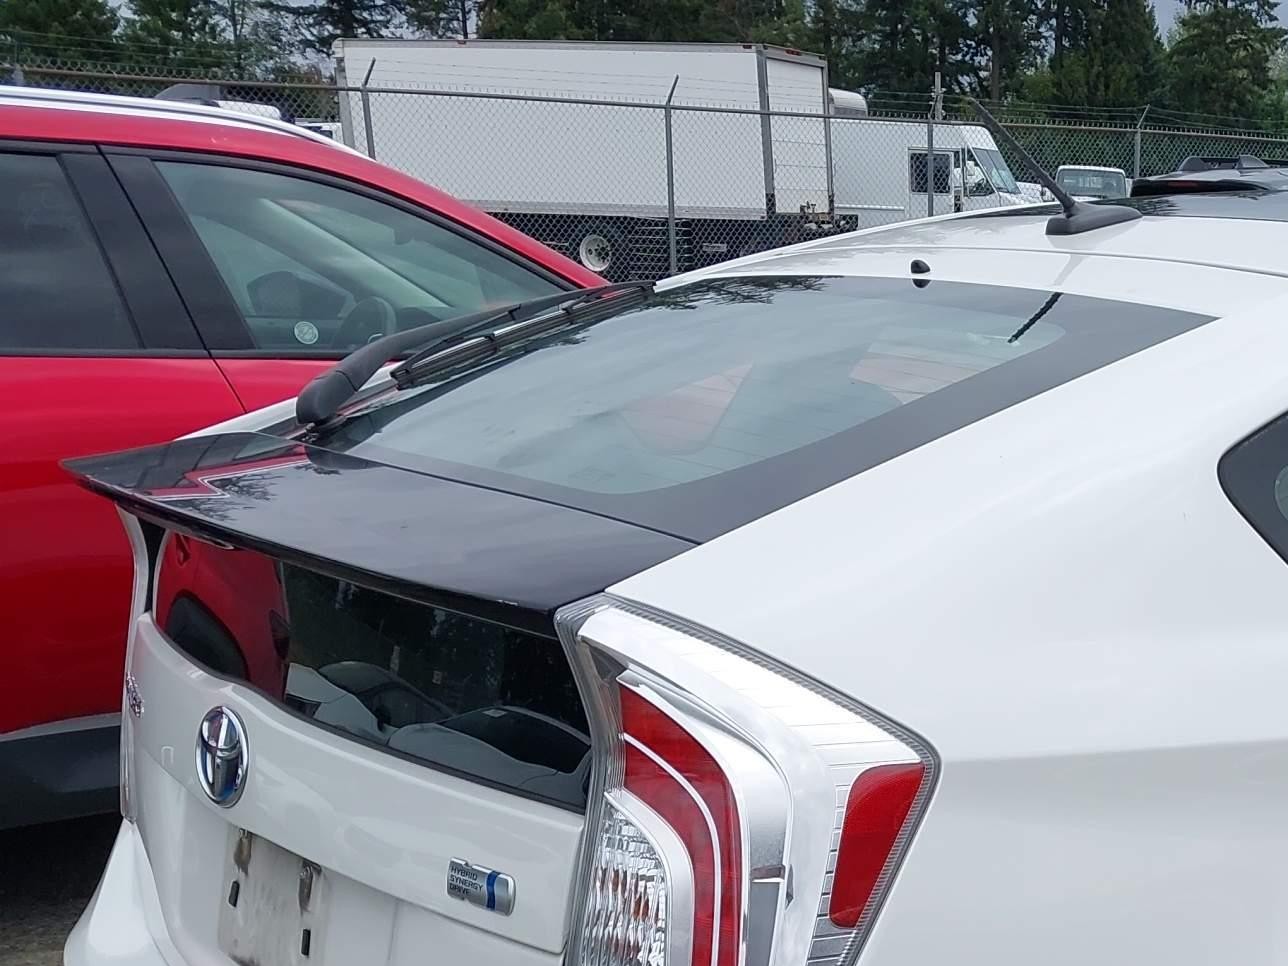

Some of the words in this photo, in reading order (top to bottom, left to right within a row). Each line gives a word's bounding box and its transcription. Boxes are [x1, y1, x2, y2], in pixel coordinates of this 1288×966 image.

[450, 865, 478, 881] HYBRID
[449, 874, 484, 892] SYNERGY
[449, 883, 472, 896] DRIVE
